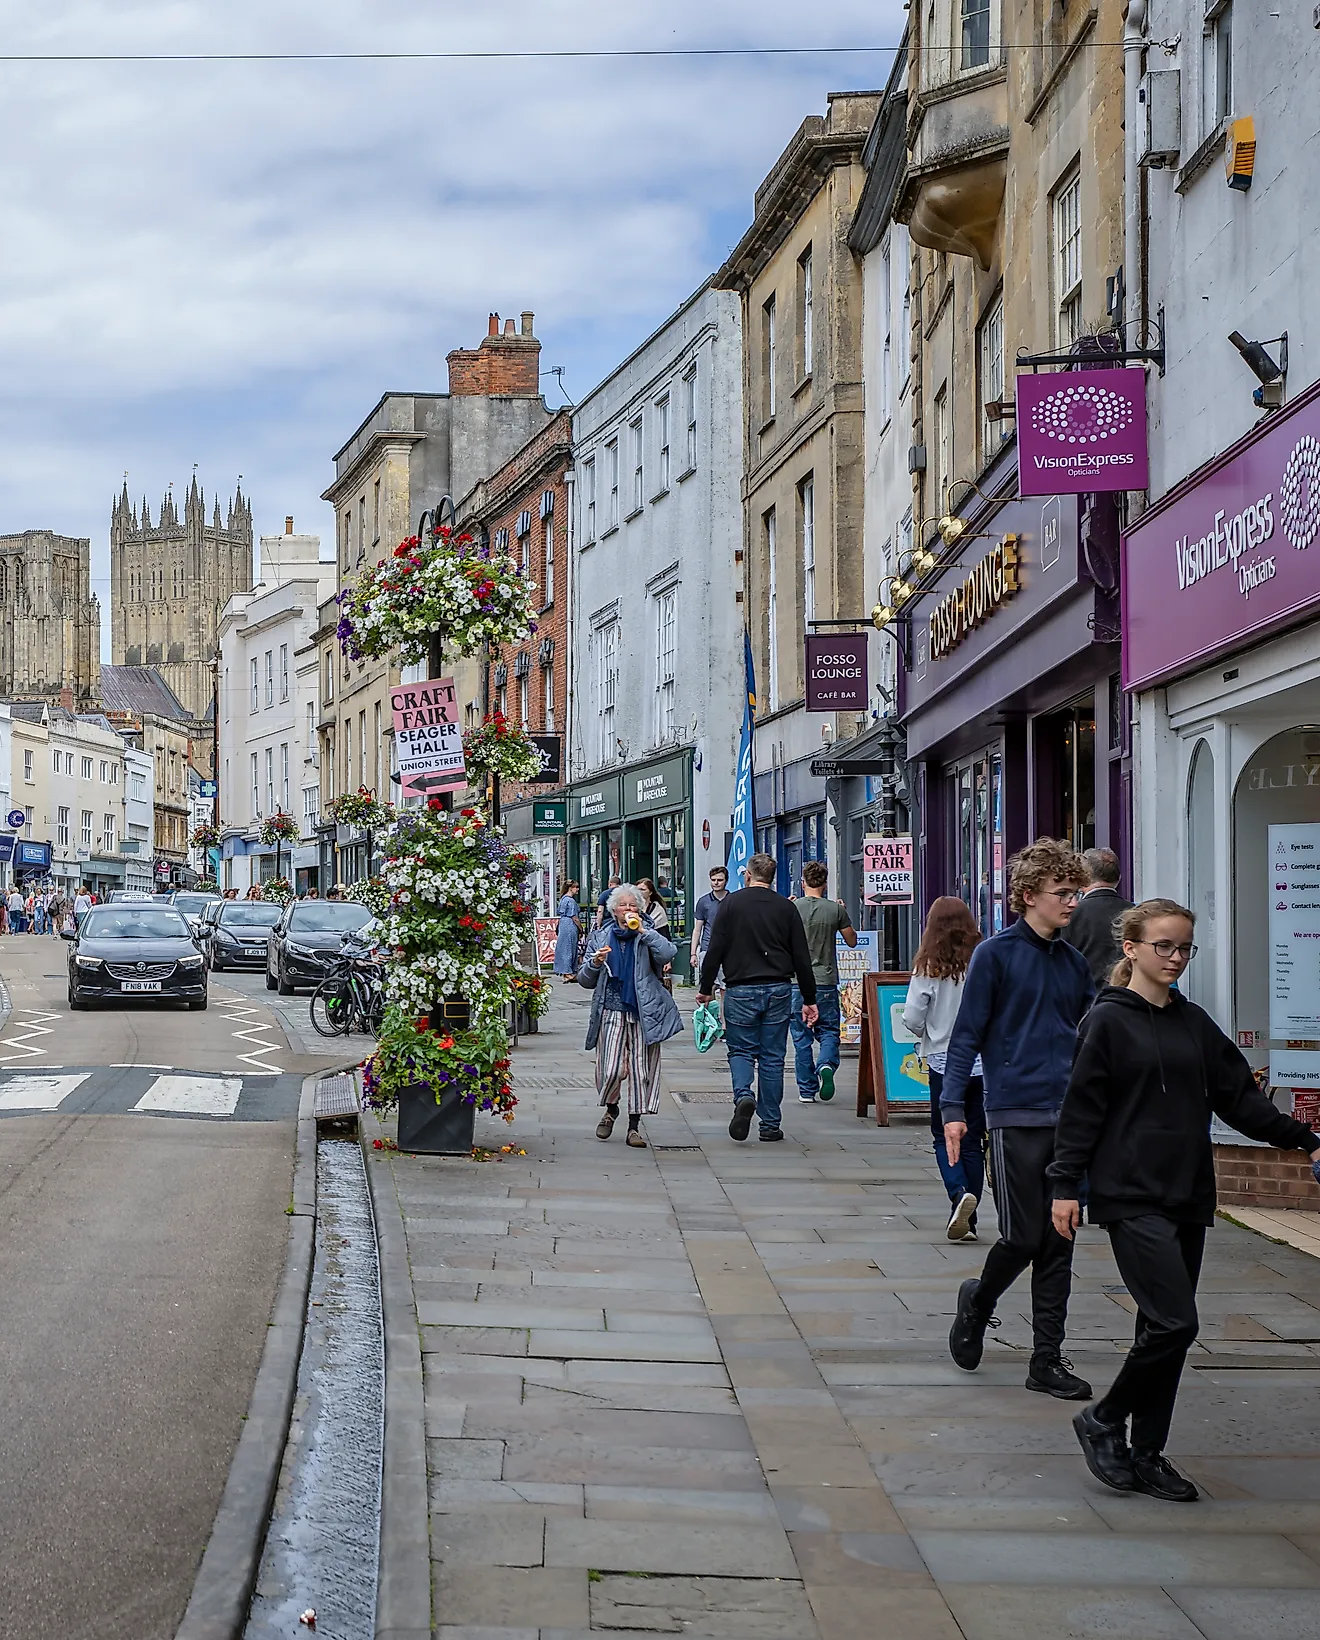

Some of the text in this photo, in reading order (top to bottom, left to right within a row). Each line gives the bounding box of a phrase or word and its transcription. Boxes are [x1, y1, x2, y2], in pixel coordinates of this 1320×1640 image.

[1033, 452, 1134, 470] VisionExpress
[1067, 468, 1101, 477] Opticians
[1044, 515, 1057, 548] BAR
[1175, 493, 1275, 590] VisionExpress
[1238, 555, 1276, 600] Opticians
[929, 533, 1018, 661] FOSSO LOUNGE
[816, 654, 856, 665] FOSSO
[811, 668, 862, 678] LOUNGE
[391, 685, 454, 711] CRAFT
[402, 707, 449, 729] FAIR
[400, 724, 457, 743] SEAGER
[411, 740, 449, 755] HALL
[401, 756, 462, 771] UNION STREET
[643, 774, 664, 789] MOUNTAIN
[585, 792, 603, 804] MOUNTAIN
[643, 786, 668, 801] WAREHOUSE
[585, 803, 606, 816] WAREHOUSE
[864, 843, 911, 856] CRAFT
[871, 857, 905, 868] FAIR
[869, 873, 910, 882] SEAGER
[876, 883, 903, 891] HALL
[838, 950, 867, 960] TASTY
[1277, 1071, 1306, 1080] Providing
